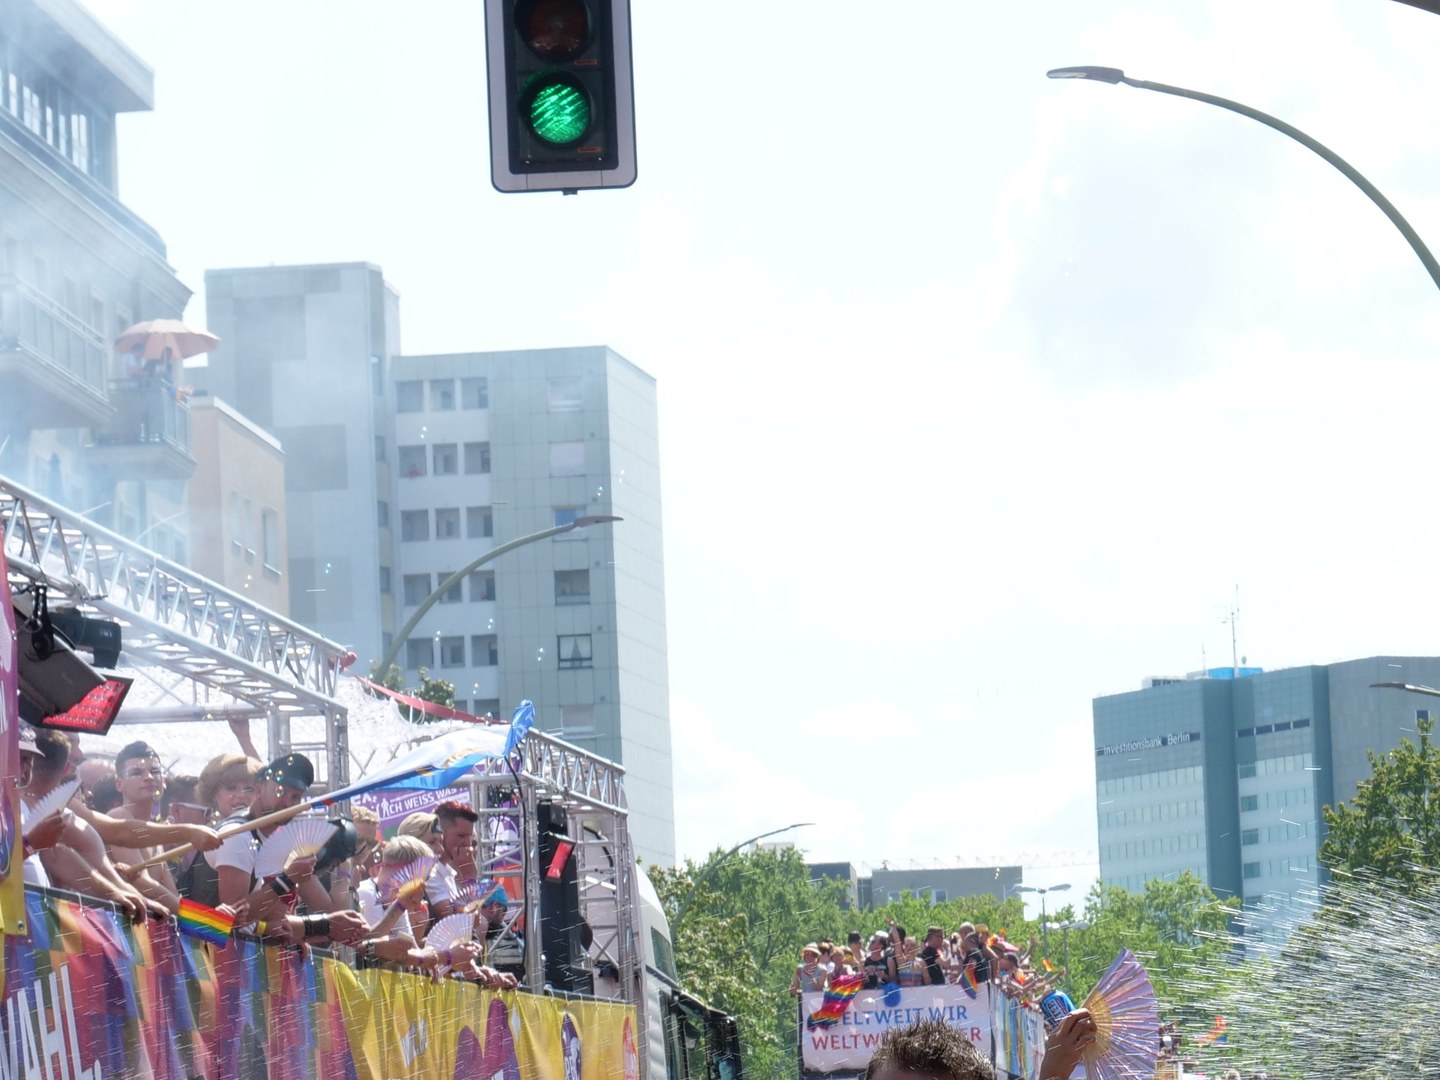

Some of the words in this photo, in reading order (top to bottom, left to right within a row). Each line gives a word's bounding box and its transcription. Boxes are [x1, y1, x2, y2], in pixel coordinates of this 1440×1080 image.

[1103, 737, 1162, 755] Investitionsbank
[1167, 732, 1190, 745] Berlin
[404, 790, 434, 810] WEISS
[838, 1006, 925, 1027] ELTWEIT
[929, 1000, 967, 1023] WIR
